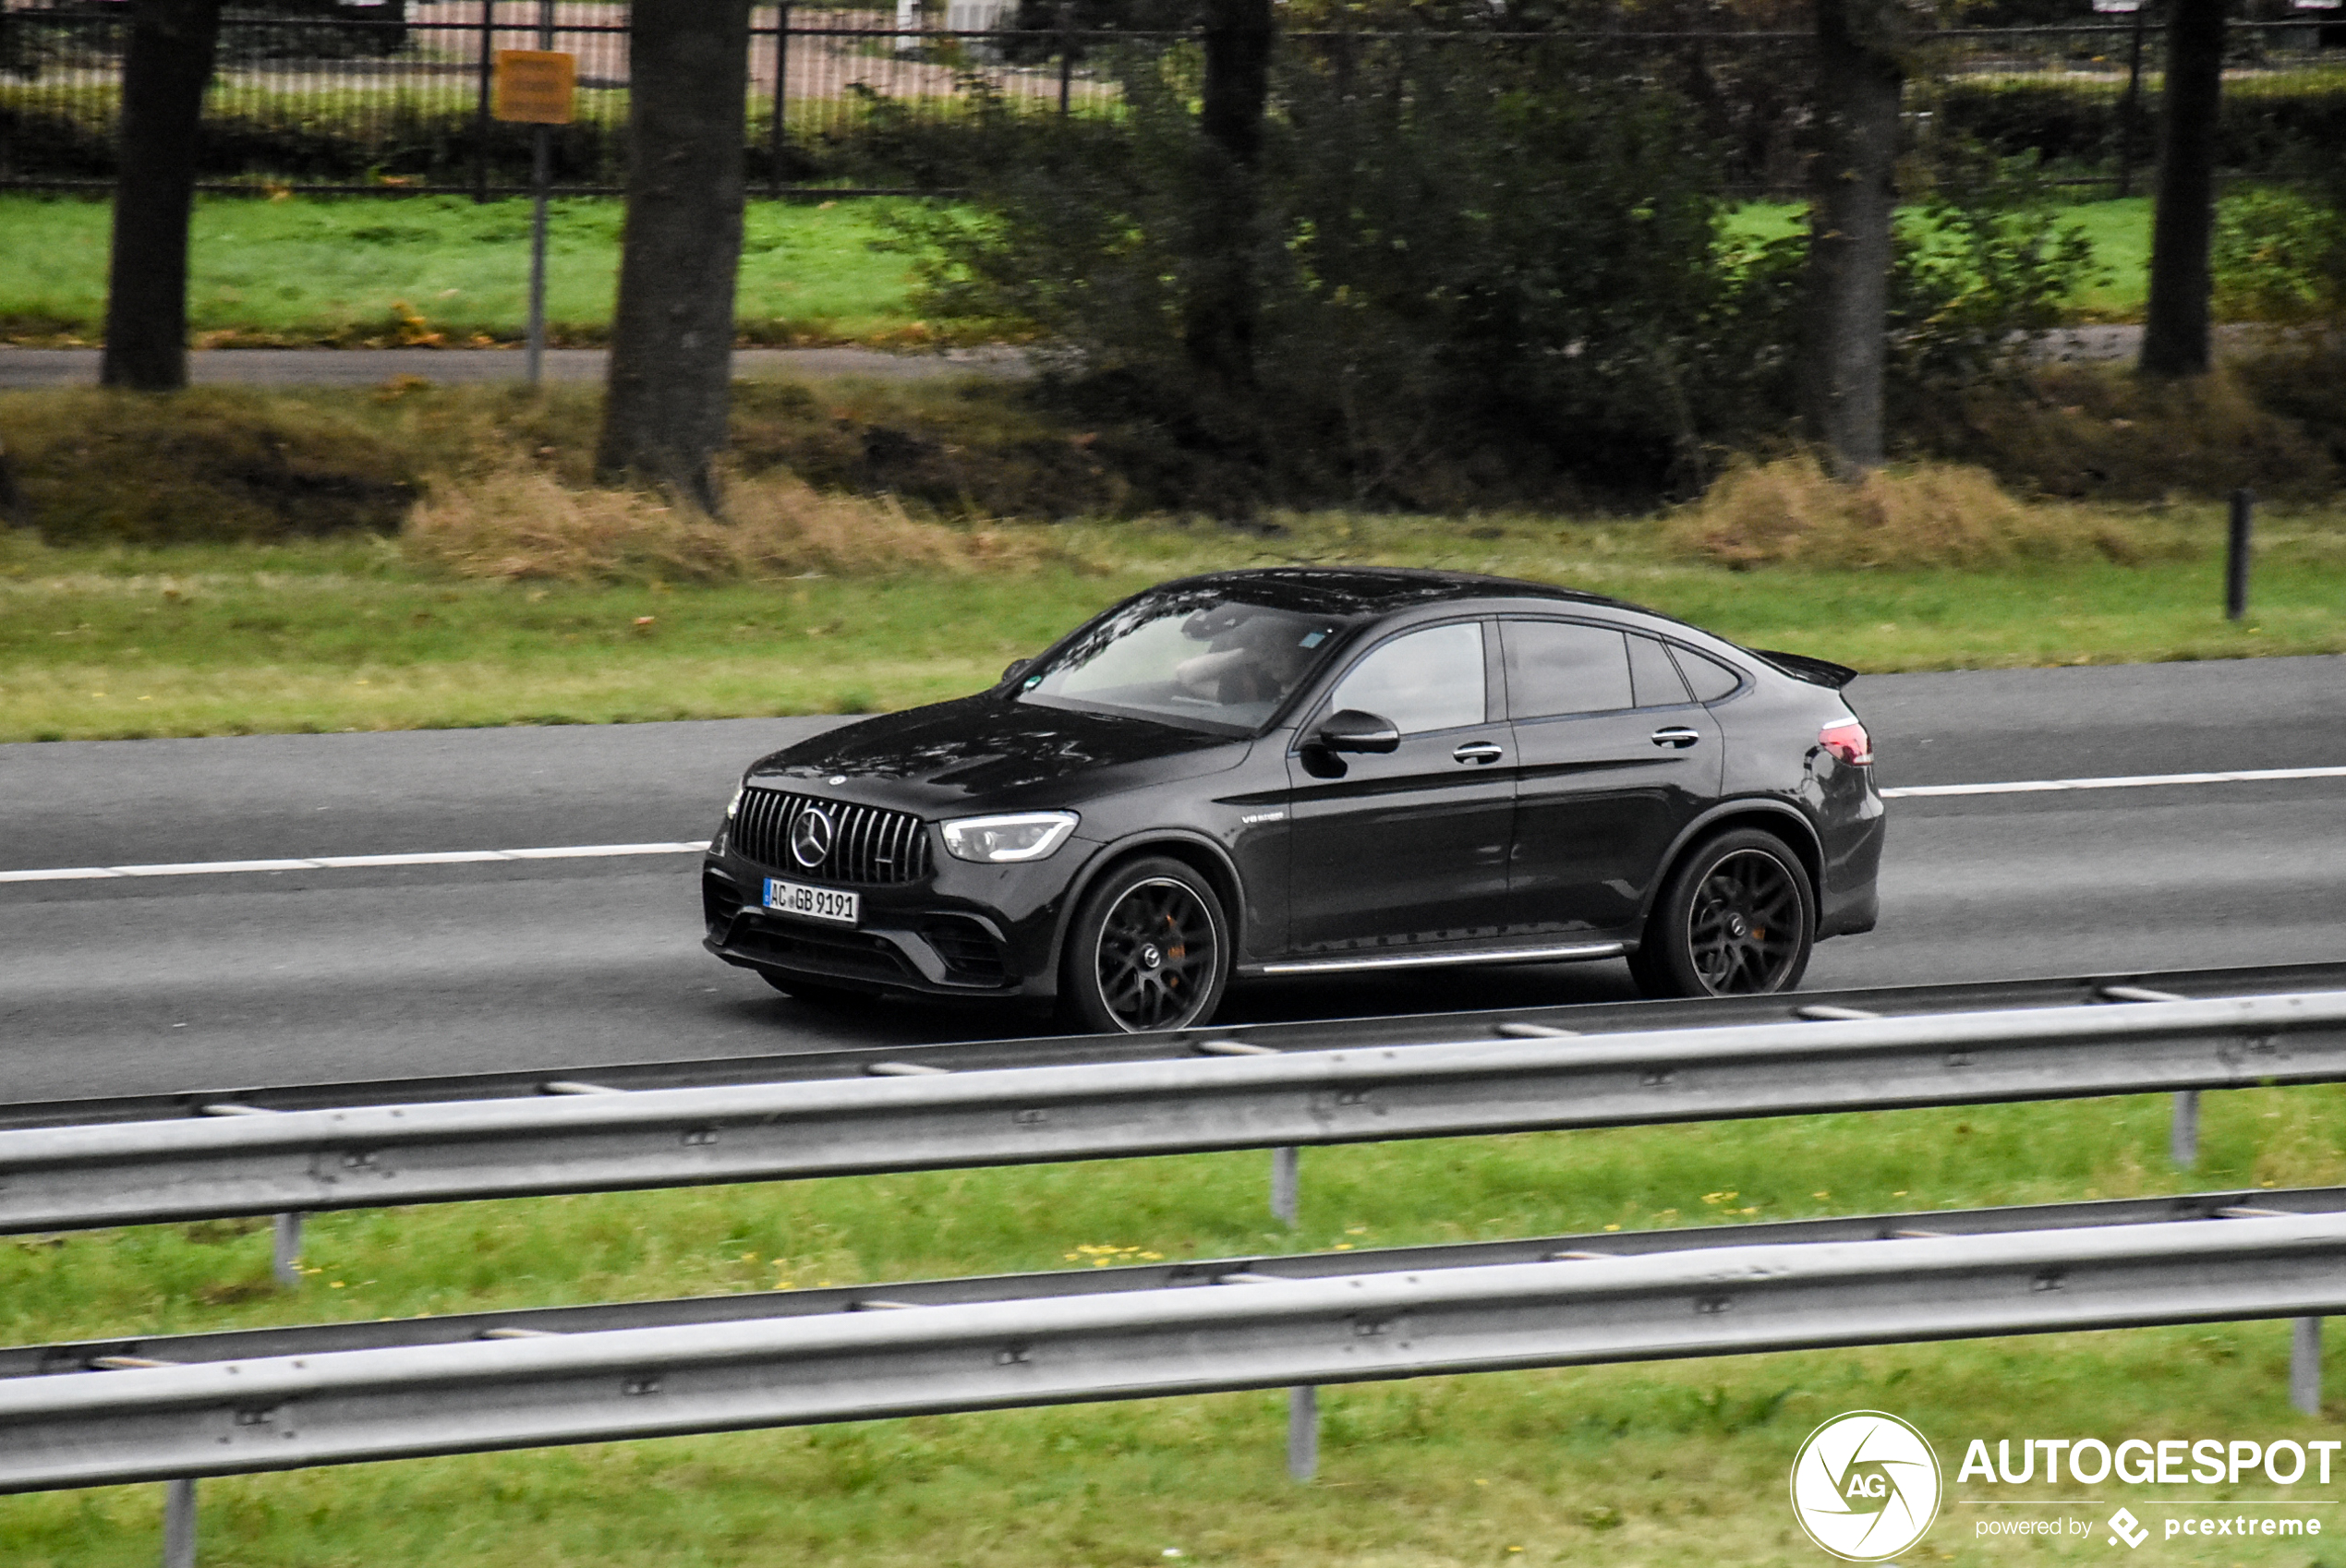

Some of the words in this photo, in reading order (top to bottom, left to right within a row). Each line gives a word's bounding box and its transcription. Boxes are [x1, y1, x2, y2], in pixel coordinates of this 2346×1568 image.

[771, 884, 786, 907] AC
[795, 888, 813, 911] GB
[816, 892, 853, 918] 9191
